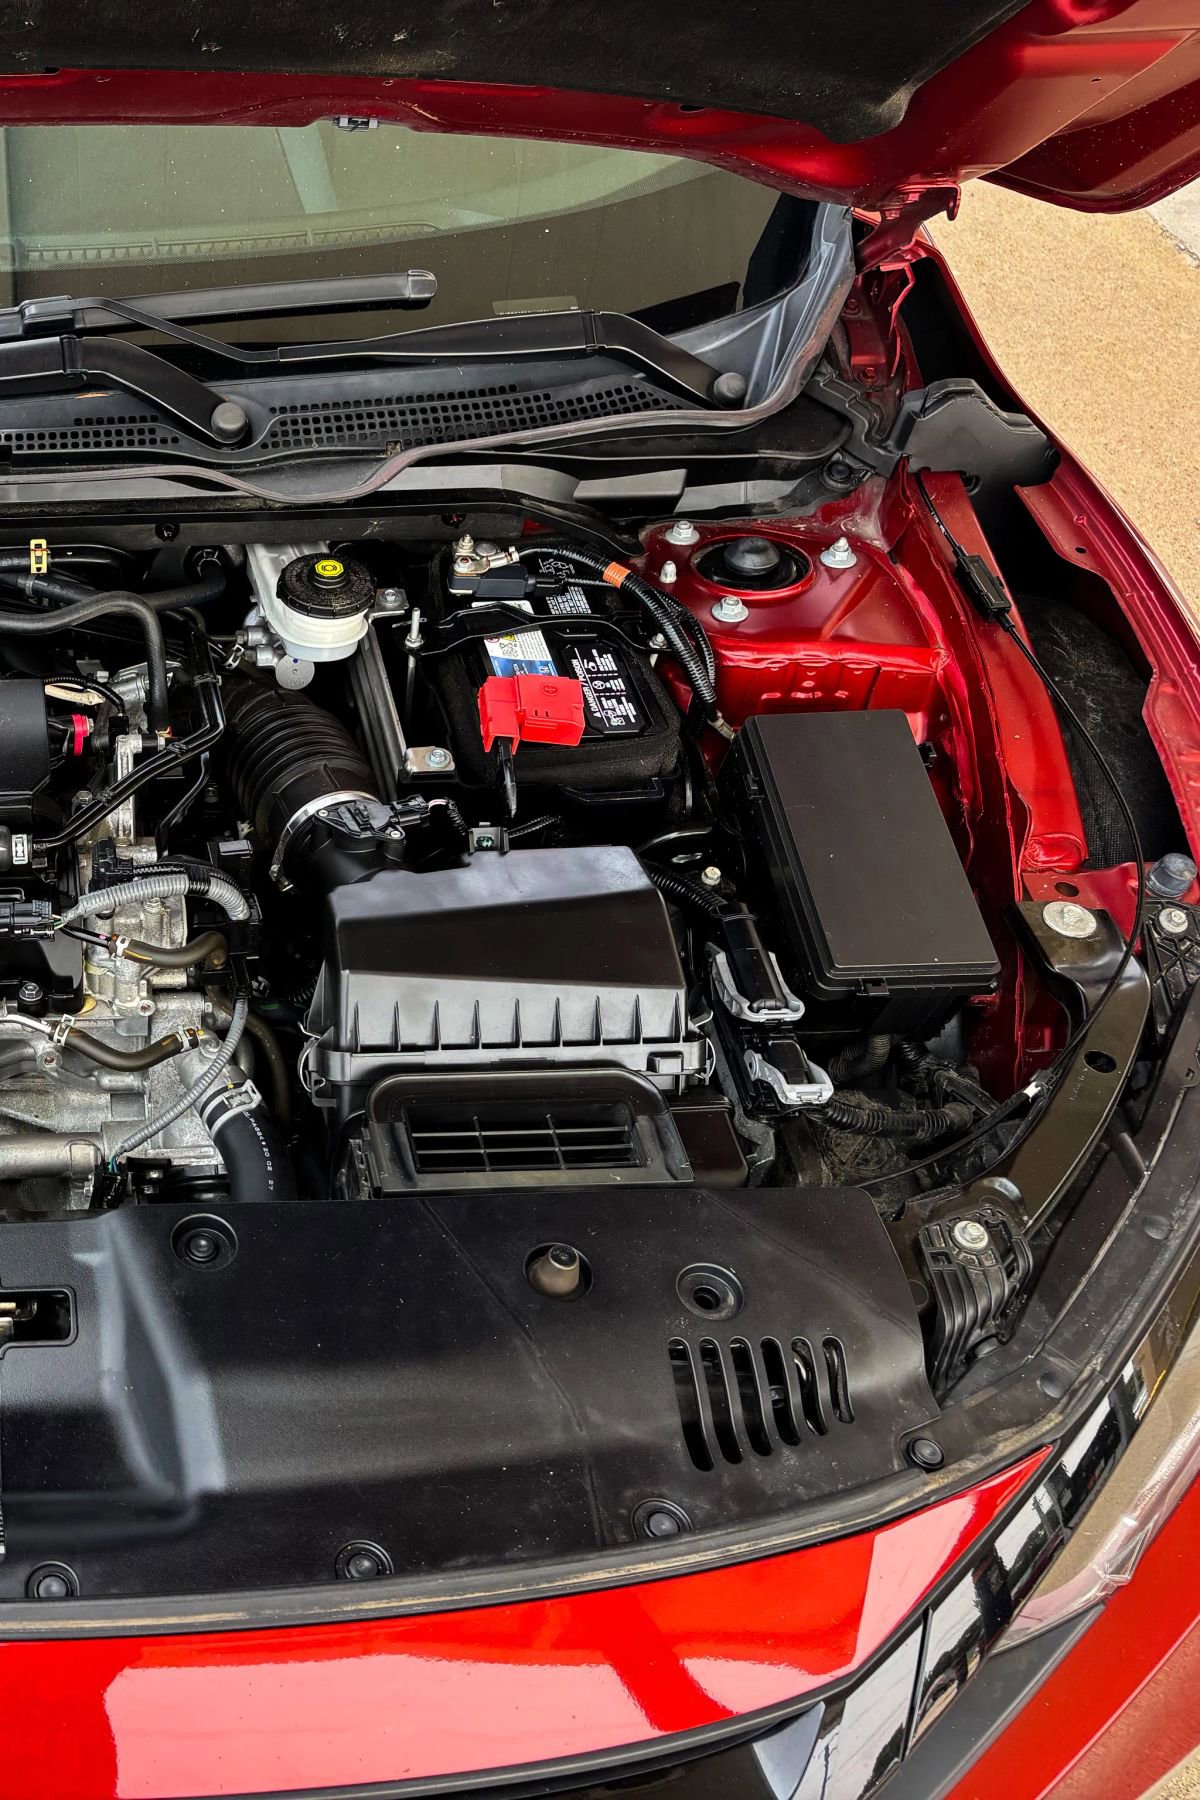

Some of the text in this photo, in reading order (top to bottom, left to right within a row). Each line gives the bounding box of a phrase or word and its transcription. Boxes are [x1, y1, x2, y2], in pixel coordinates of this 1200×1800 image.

[583, 686, 599, 711] DANGER
[263, 1147, 270, 1157] 20
[266, 1161, 273, 1171] 02
